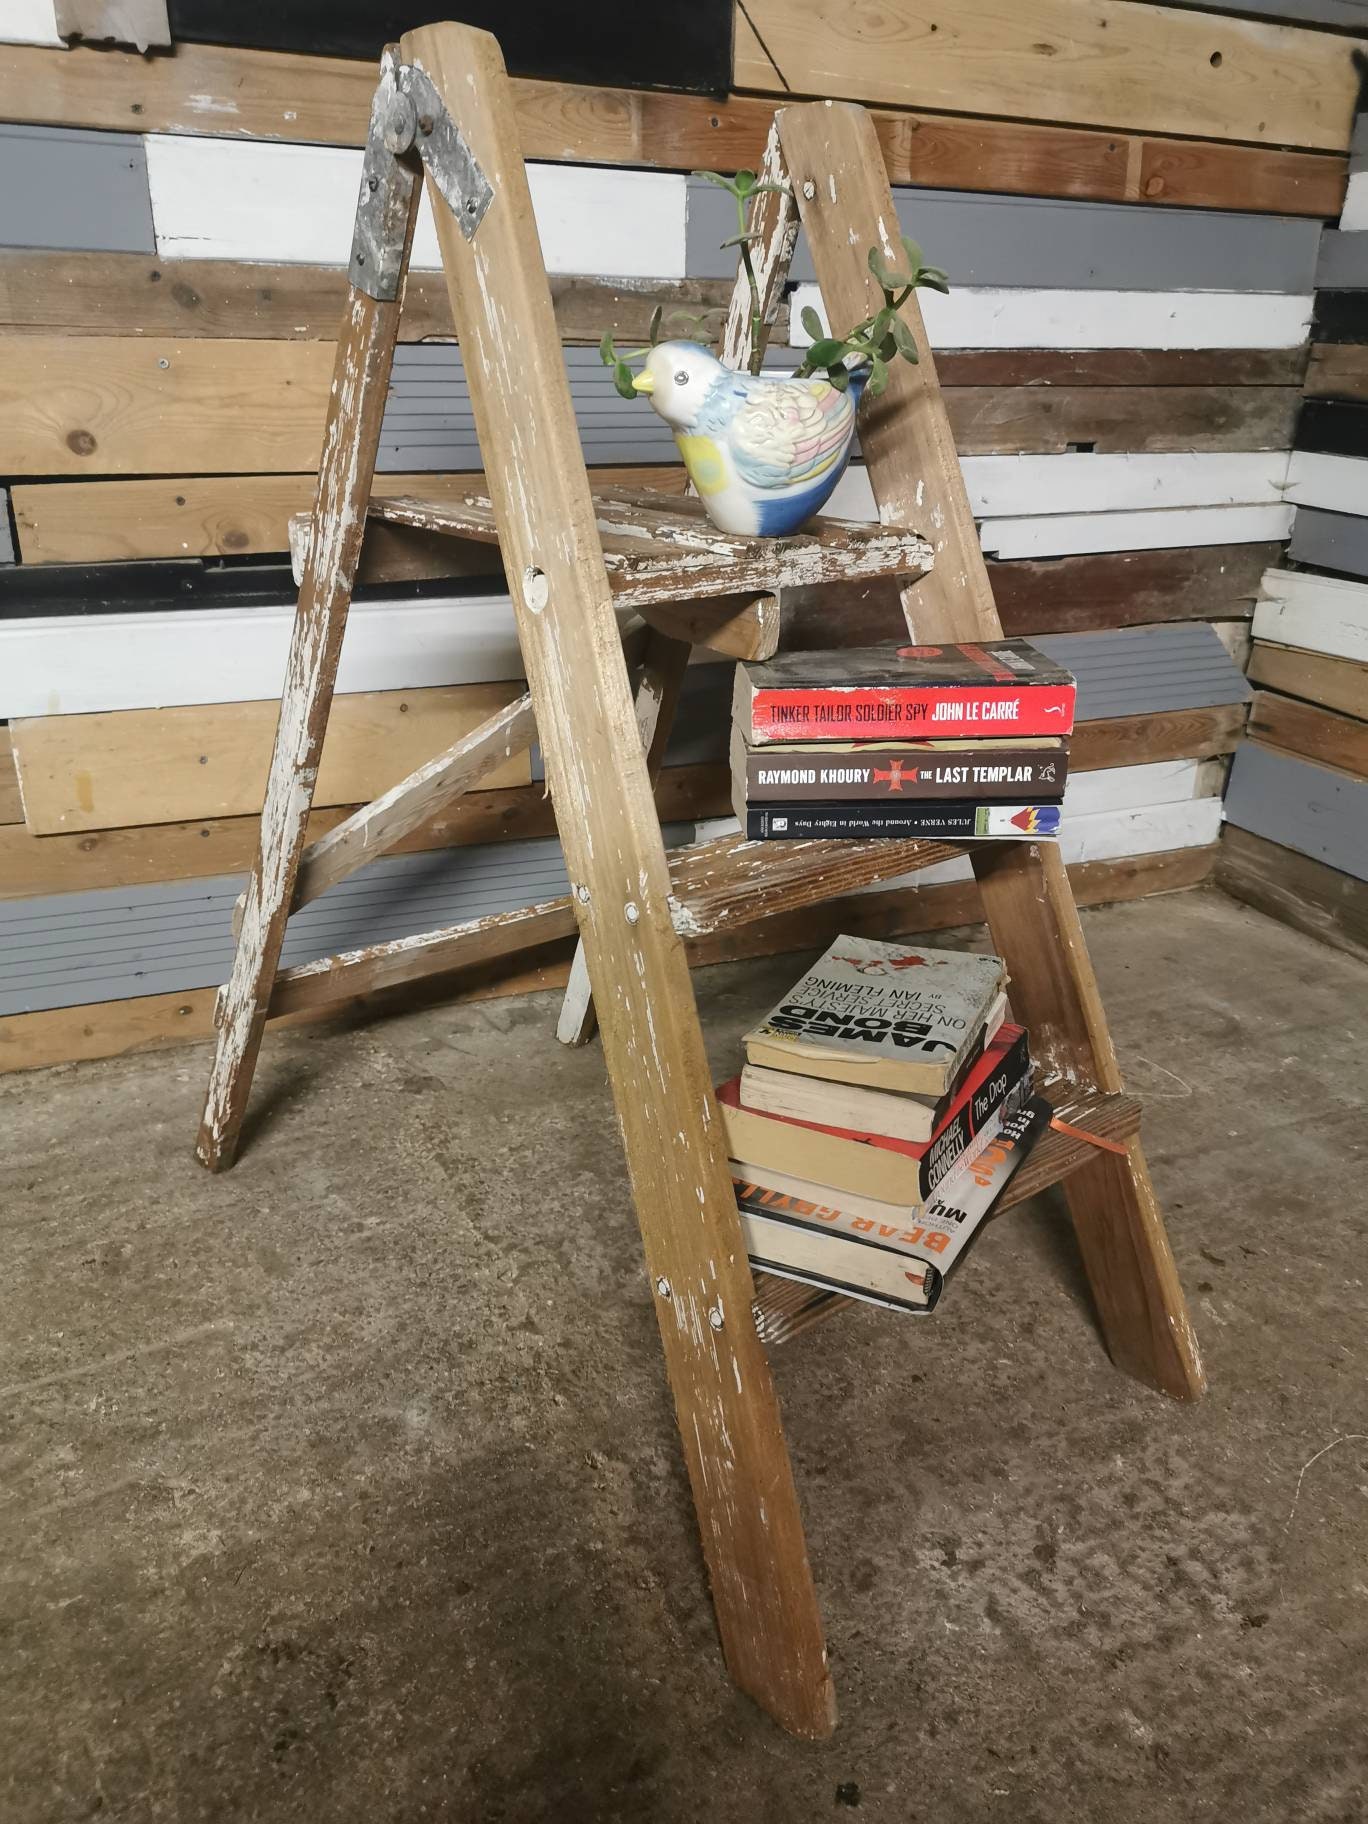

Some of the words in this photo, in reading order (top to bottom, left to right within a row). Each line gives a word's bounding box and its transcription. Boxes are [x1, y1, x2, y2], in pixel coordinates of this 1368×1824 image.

[771, 704, 810, 722] TINKER
[814, 704, 851, 722] TAILOR
[855, 703, 902, 722] SOLDIER
[906, 703, 929, 721] SPY
[931, 702, 963, 721] JOHN
[966, 702, 980, 720] LE
[982, 698, 1020, 720] CARRÉ
[758, 769, 816, 785] RAYMOND
[820, 768, 870, 784] KHOURY
[920, 770, 933, 780] THE
[936, 767, 969, 783] LAST
[972, 766, 1033, 783] TEMPLAR
[794, 819, 812, 828] Days
[814, 819, 837, 828] Eighty
[849, 819, 870, 828] World
[872, 819, 884, 827] the
[886, 819, 912, 827] Around
[920, 818, 946, 826] VERNE
[948, 818, 972, 826] JULES
[806, 976, 885, 998] FLEMING
[888, 989, 922, 1000] IAN
[788, 994, 889, 1017] MAJESTY'S
[800, 986, 862, 1009] SERVICE
[864, 997, 946, 1014] SECRET
[779, 1005, 933, 1036] BOND
[892, 1008, 933, 1027] HER
[937, 1015, 966, 1030] ON
[769, 1015, 958, 1052] JAMES
[974, 1096, 989, 1121] The
[988, 1074, 1007, 1103] Drop
[929, 1118, 962, 1165] MICHAEL
[927, 1137, 966, 1190] CONNELLY
[929, 1205, 967, 1223] MU
[851, 1216, 951, 1254] BEAR
